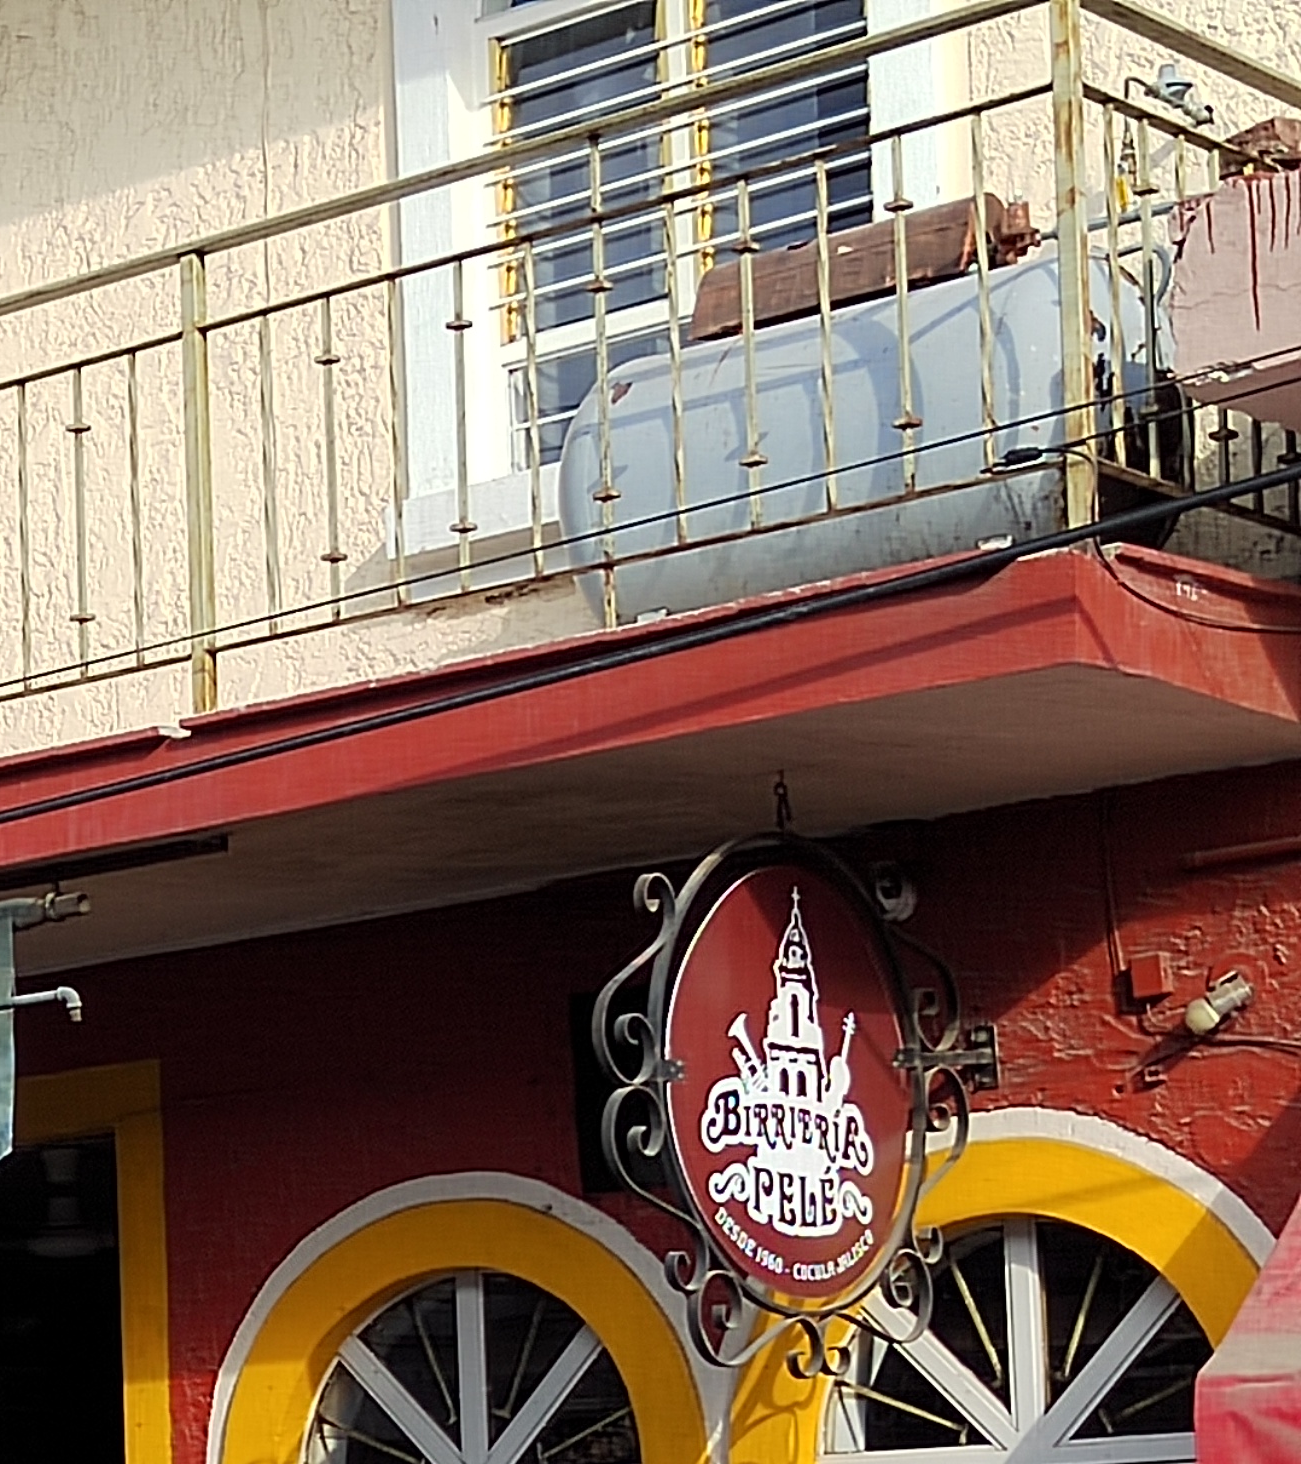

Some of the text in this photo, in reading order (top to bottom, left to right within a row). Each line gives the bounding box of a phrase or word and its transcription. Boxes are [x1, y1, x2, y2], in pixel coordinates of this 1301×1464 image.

[752, 1166, 838, 1227] PELÉ
[713, 1206, 757, 1258] DESDE
[754, 1246, 784, 1274] 1960
